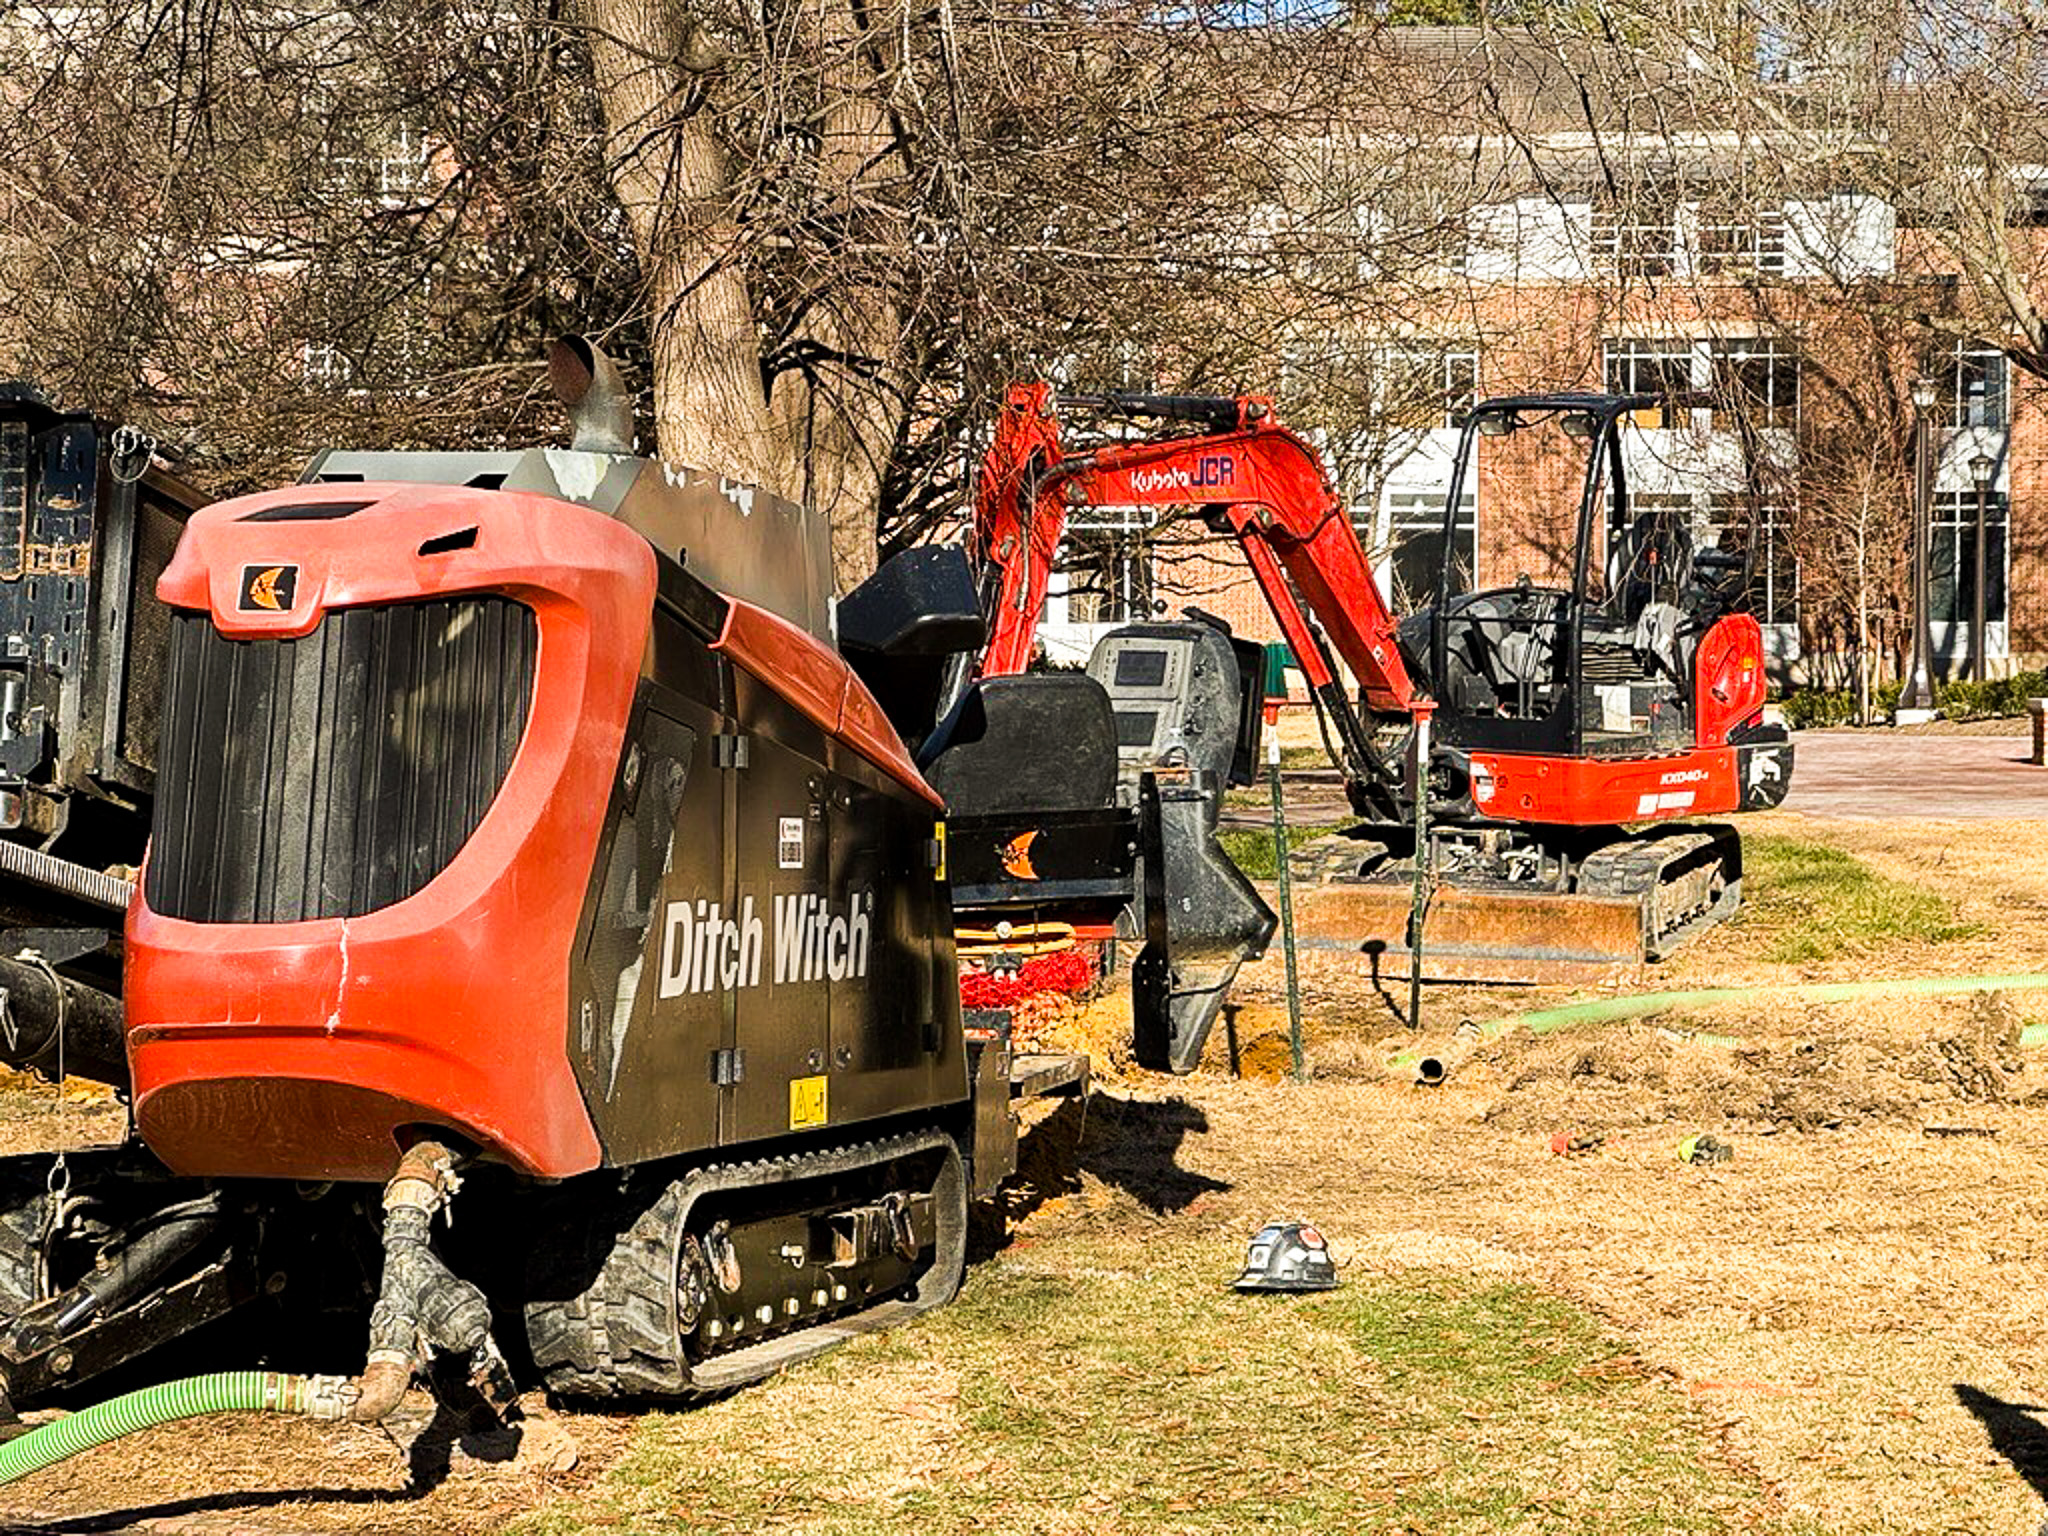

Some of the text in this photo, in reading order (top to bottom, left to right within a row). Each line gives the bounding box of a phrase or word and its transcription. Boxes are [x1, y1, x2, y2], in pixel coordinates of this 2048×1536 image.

[1131, 467, 1188, 492] Kubota
[1190, 456, 1234, 486] JCR
[659, 893, 869, 999] Ditch Witch
